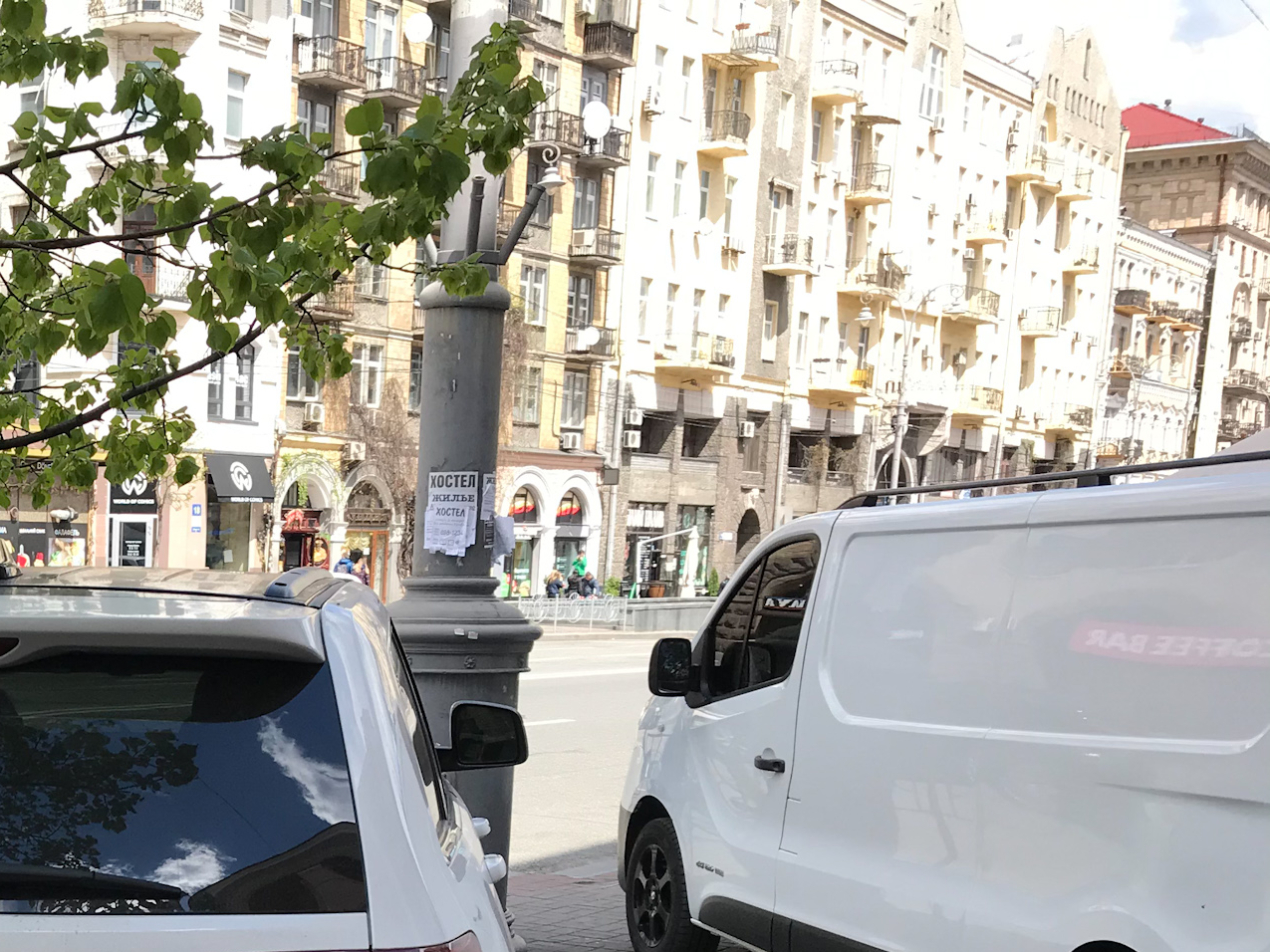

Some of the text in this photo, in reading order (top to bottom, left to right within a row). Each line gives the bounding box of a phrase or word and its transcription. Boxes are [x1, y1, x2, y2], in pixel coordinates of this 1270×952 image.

[430, 474, 476, 489] ХОСТЕЛ
[432, 494, 475, 502] ЖИЛЬЕ
[435, 507, 465, 517] ХОСТЕЛ
